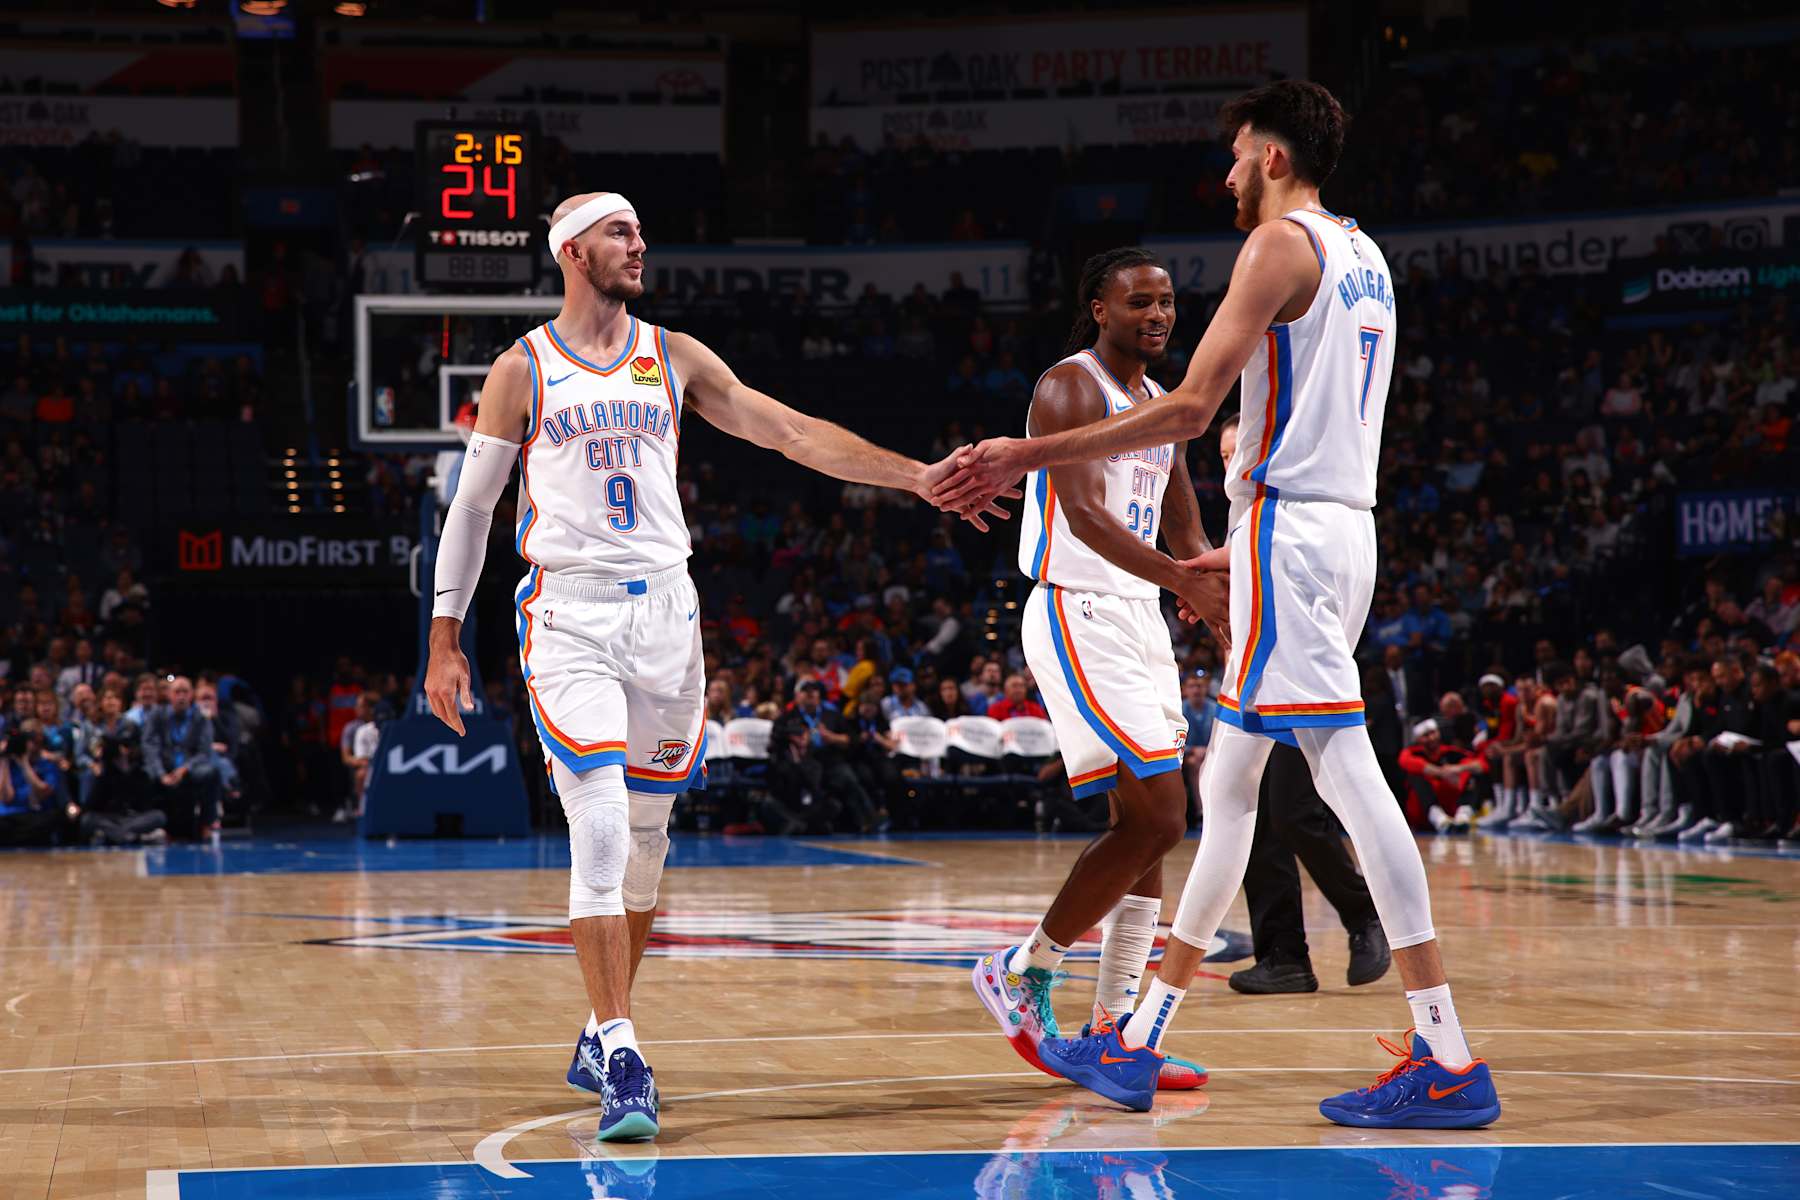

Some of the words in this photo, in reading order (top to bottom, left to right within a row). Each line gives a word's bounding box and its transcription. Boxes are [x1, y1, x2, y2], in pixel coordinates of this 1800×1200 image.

[860, 57, 928, 91] POST
[968, 53, 1021, 87] OAK
[1031, 49, 1128, 84] PARTY
[1136, 41, 1272, 79] TERRACE
[882, 111, 925, 131] POST
[951, 108, 989, 130] OAK
[1117, 102, 1162, 126] POST
[440, 162, 517, 221] 24
[457, 230, 531, 247] TISSOT
[1656, 265, 1751, 291] Dobson
[32, 302, 63, 322] for
[67, 302, 219, 325] Oklahomans.
[1359, 325, 1384, 427] 7
[542, 400, 672, 447] OKLAHOMA
[585, 435, 642, 472] CITY
[604, 472, 639, 534] 9
[1680, 496, 1774, 544] HOME
